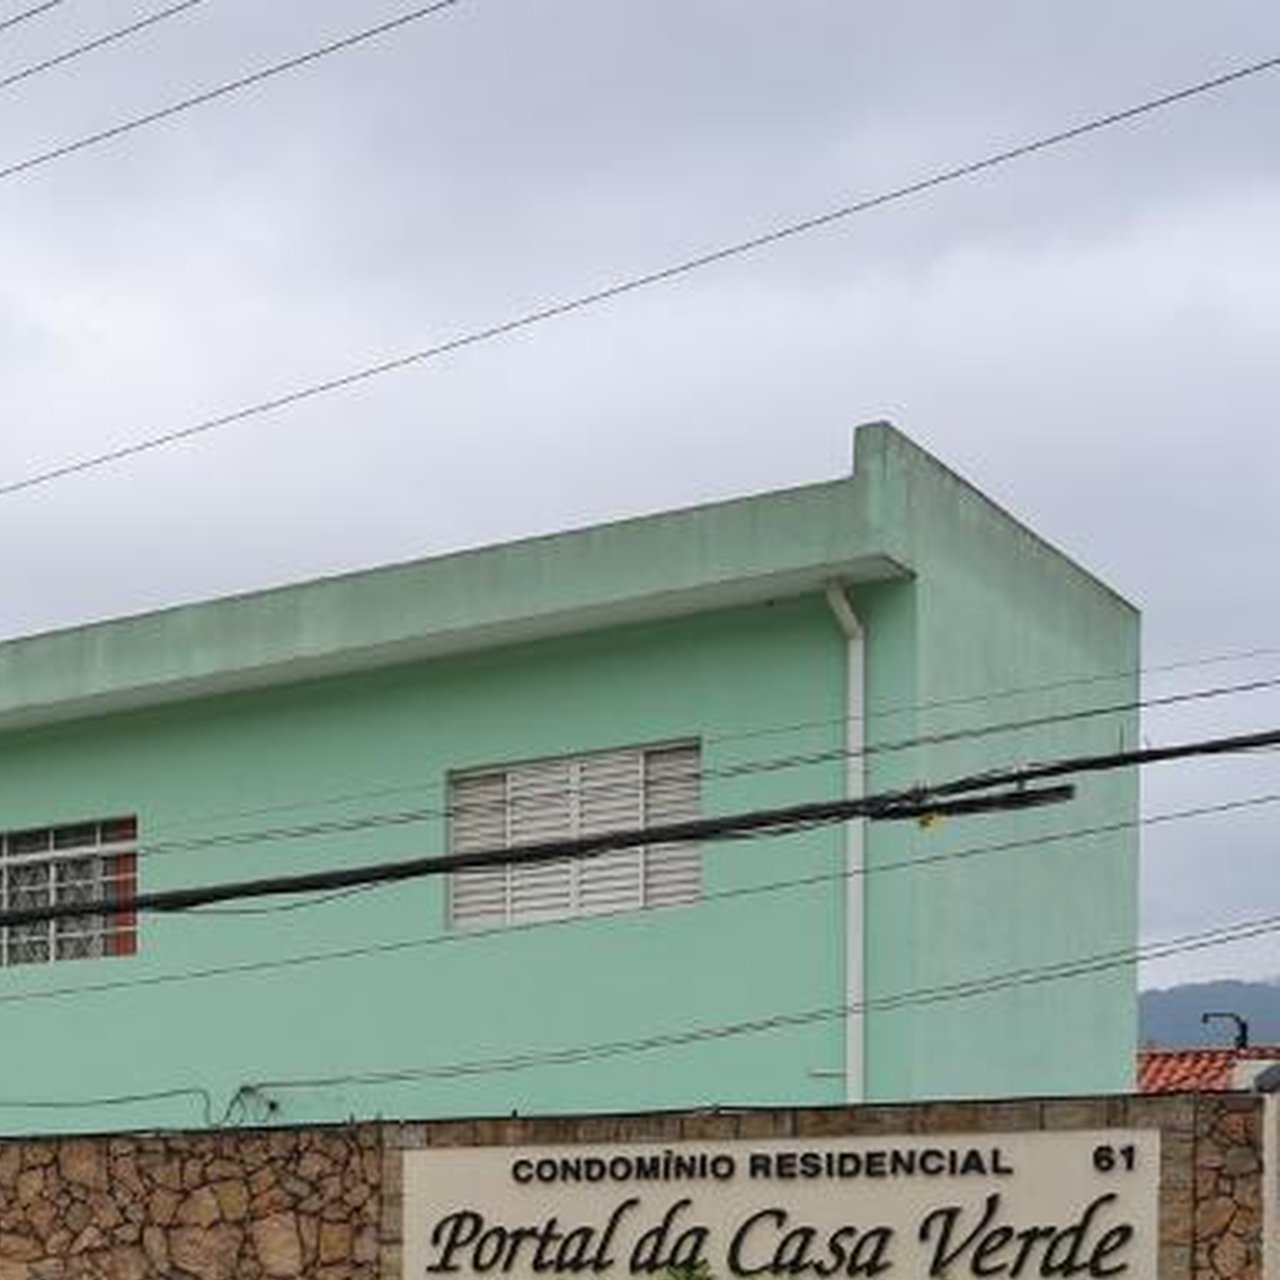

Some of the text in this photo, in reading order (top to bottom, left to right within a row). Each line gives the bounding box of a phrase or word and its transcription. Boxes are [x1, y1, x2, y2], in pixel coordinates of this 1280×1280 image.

[511, 1147, 1015, 1185] CONDOMÍNIO RESIDENCIAL
[1091, 1144, 1137, 1174] 61
[425, 1191, 1136, 1280] Portal da Casa Verde
